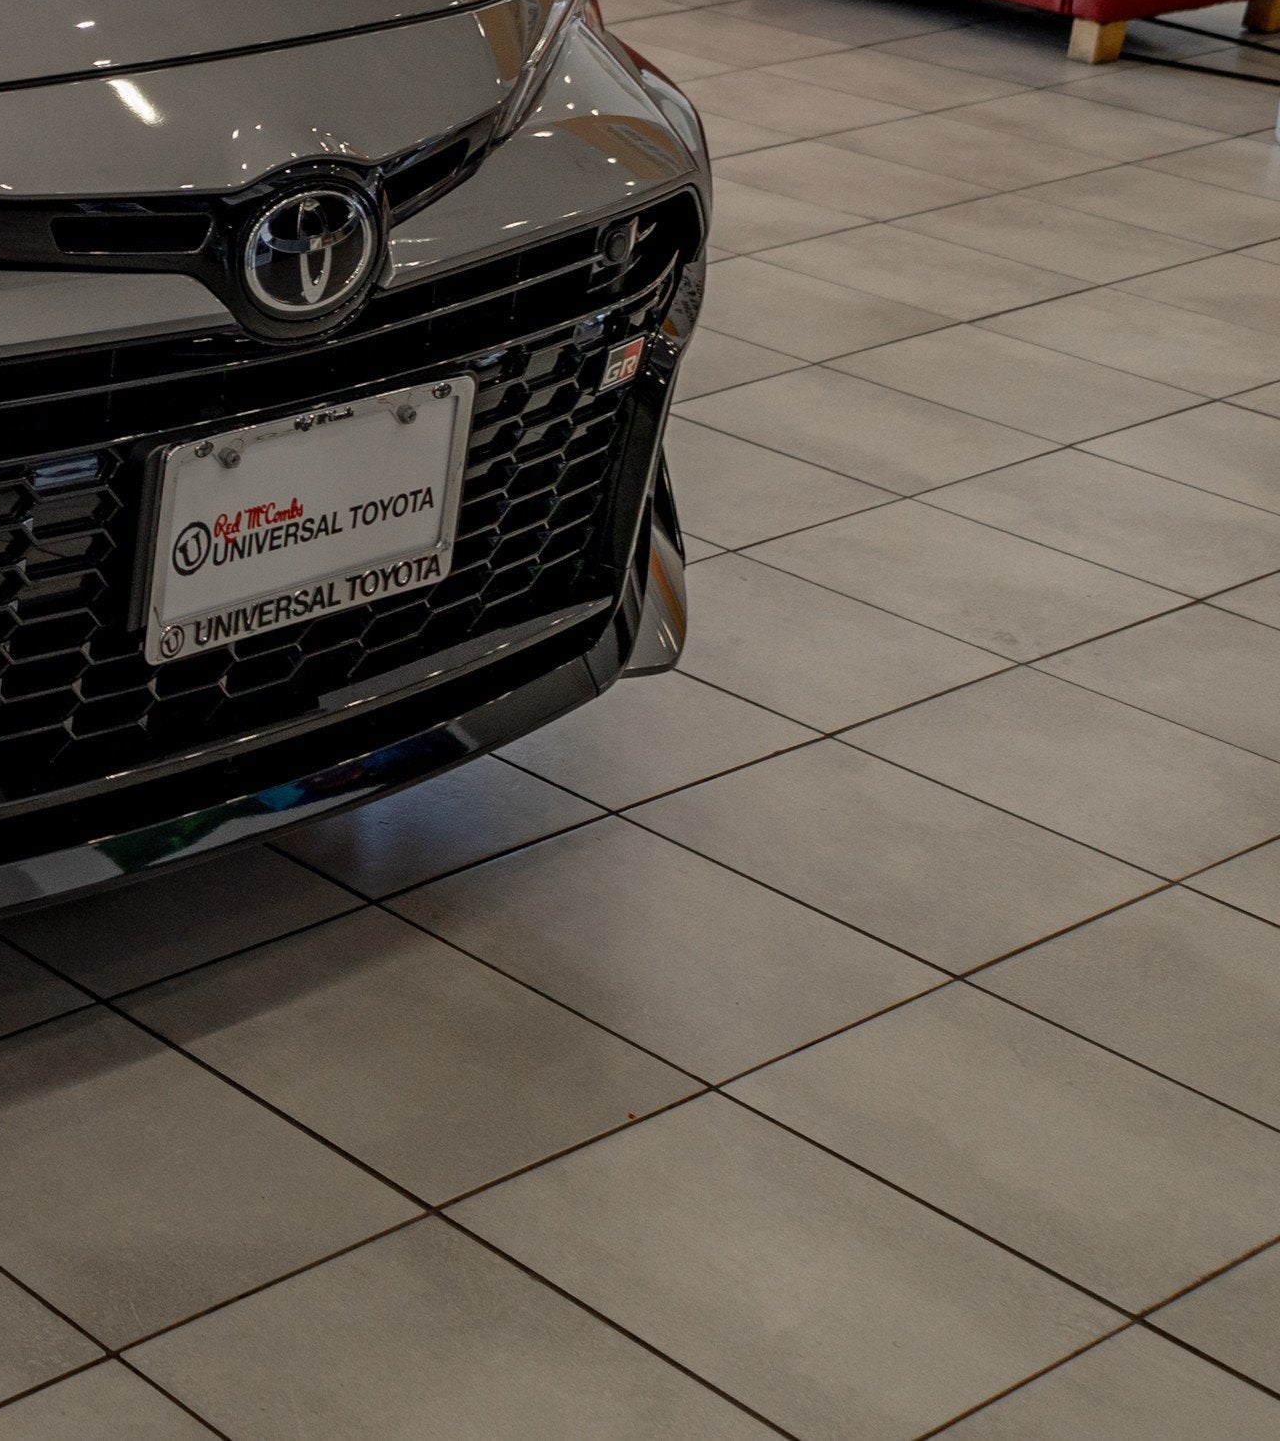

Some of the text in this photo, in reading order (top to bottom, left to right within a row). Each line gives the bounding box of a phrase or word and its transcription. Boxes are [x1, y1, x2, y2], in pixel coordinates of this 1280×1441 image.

[604, 355, 638, 385] GR
[212, 511, 343, 566] UNIVERSAL
[349, 487, 434, 529] TOYOTA
[213, 510, 242, 544] Red
[194, 581, 342, 646] UNIVERSAL
[345, 554, 441, 601] TOYOTA
